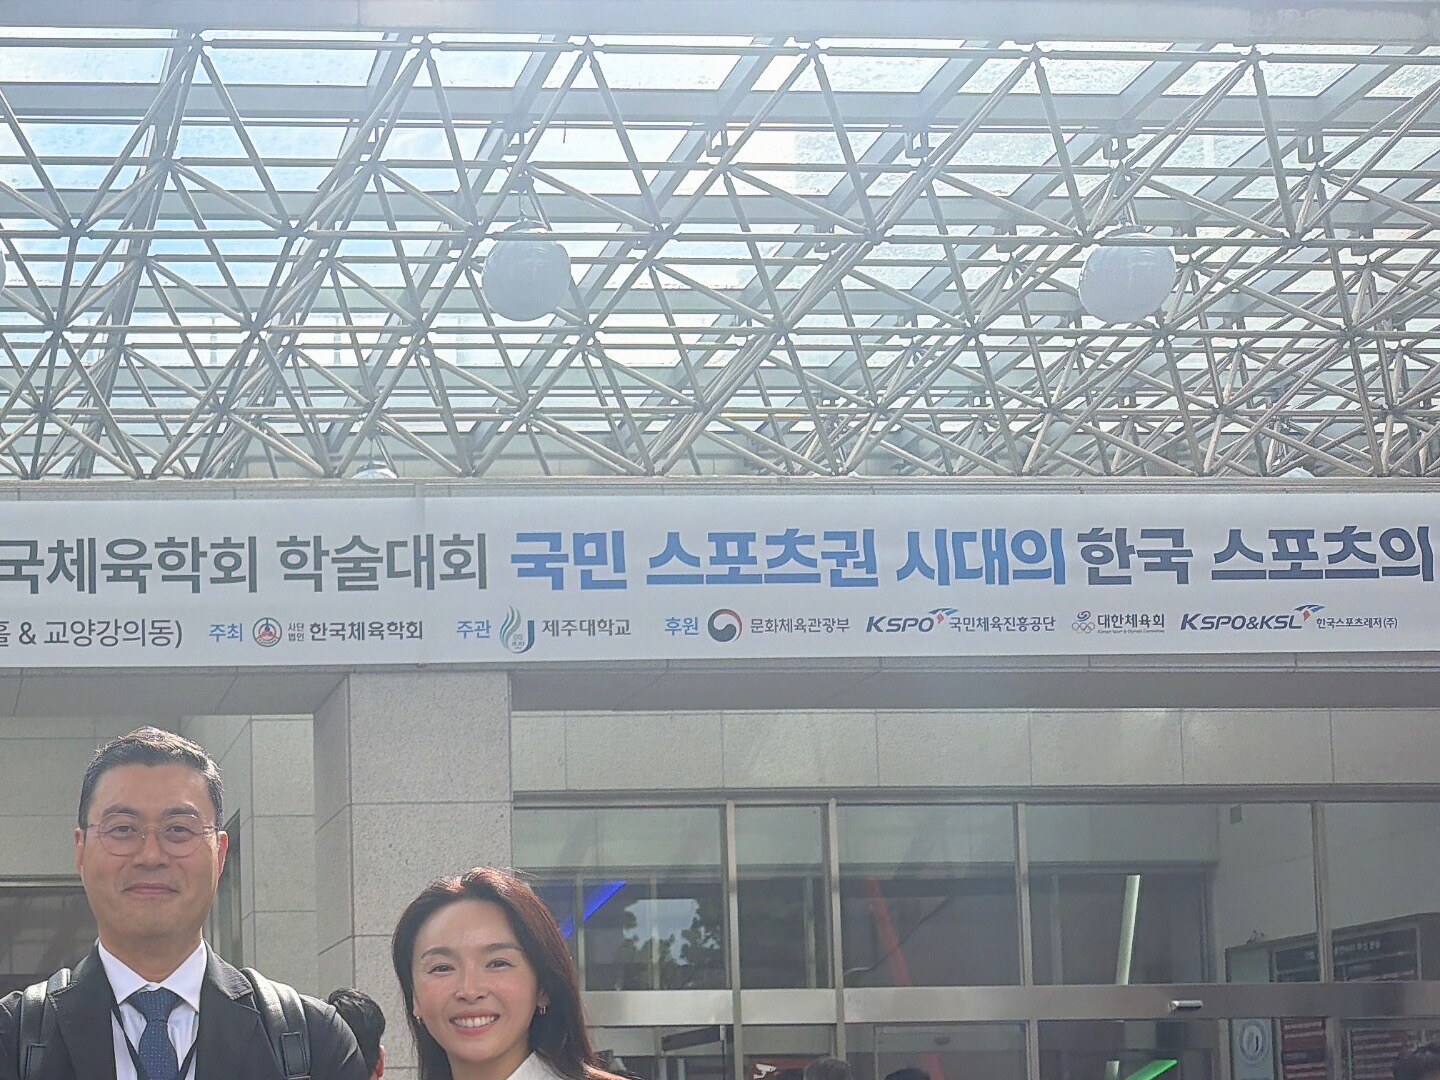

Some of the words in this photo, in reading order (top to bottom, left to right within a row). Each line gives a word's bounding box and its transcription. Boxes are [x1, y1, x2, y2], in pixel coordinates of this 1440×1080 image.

[276, 533, 488, 592] 학술대회
[511, 530, 627, 590] 국민
[646, 528, 879, 588] 스포츠권
[896, 528, 1066, 586] 시대의
[1077, 527, 1194, 585] 한국
[1211, 526, 1435, 582] 스포츠의
[310, 620, 424, 641] 한국체육학회
[456, 619, 492, 639] 주관
[542, 617, 632, 637] 제주대학교
[664, 616, 699, 636] 후원
[750, 616, 850, 635] 문화체육관광부
[866, 616, 935, 633] KSPO
[948, 615, 1057, 633] 국민체육진흥공단
[1097, 613, 1166, 629] 대한체육회
[1180, 612, 1304, 631] KSPO&KSL
[18, 621, 37, 645] &
[43, 618, 183, 648] 교양강의동)
[209, 622, 244, 643] 주최
